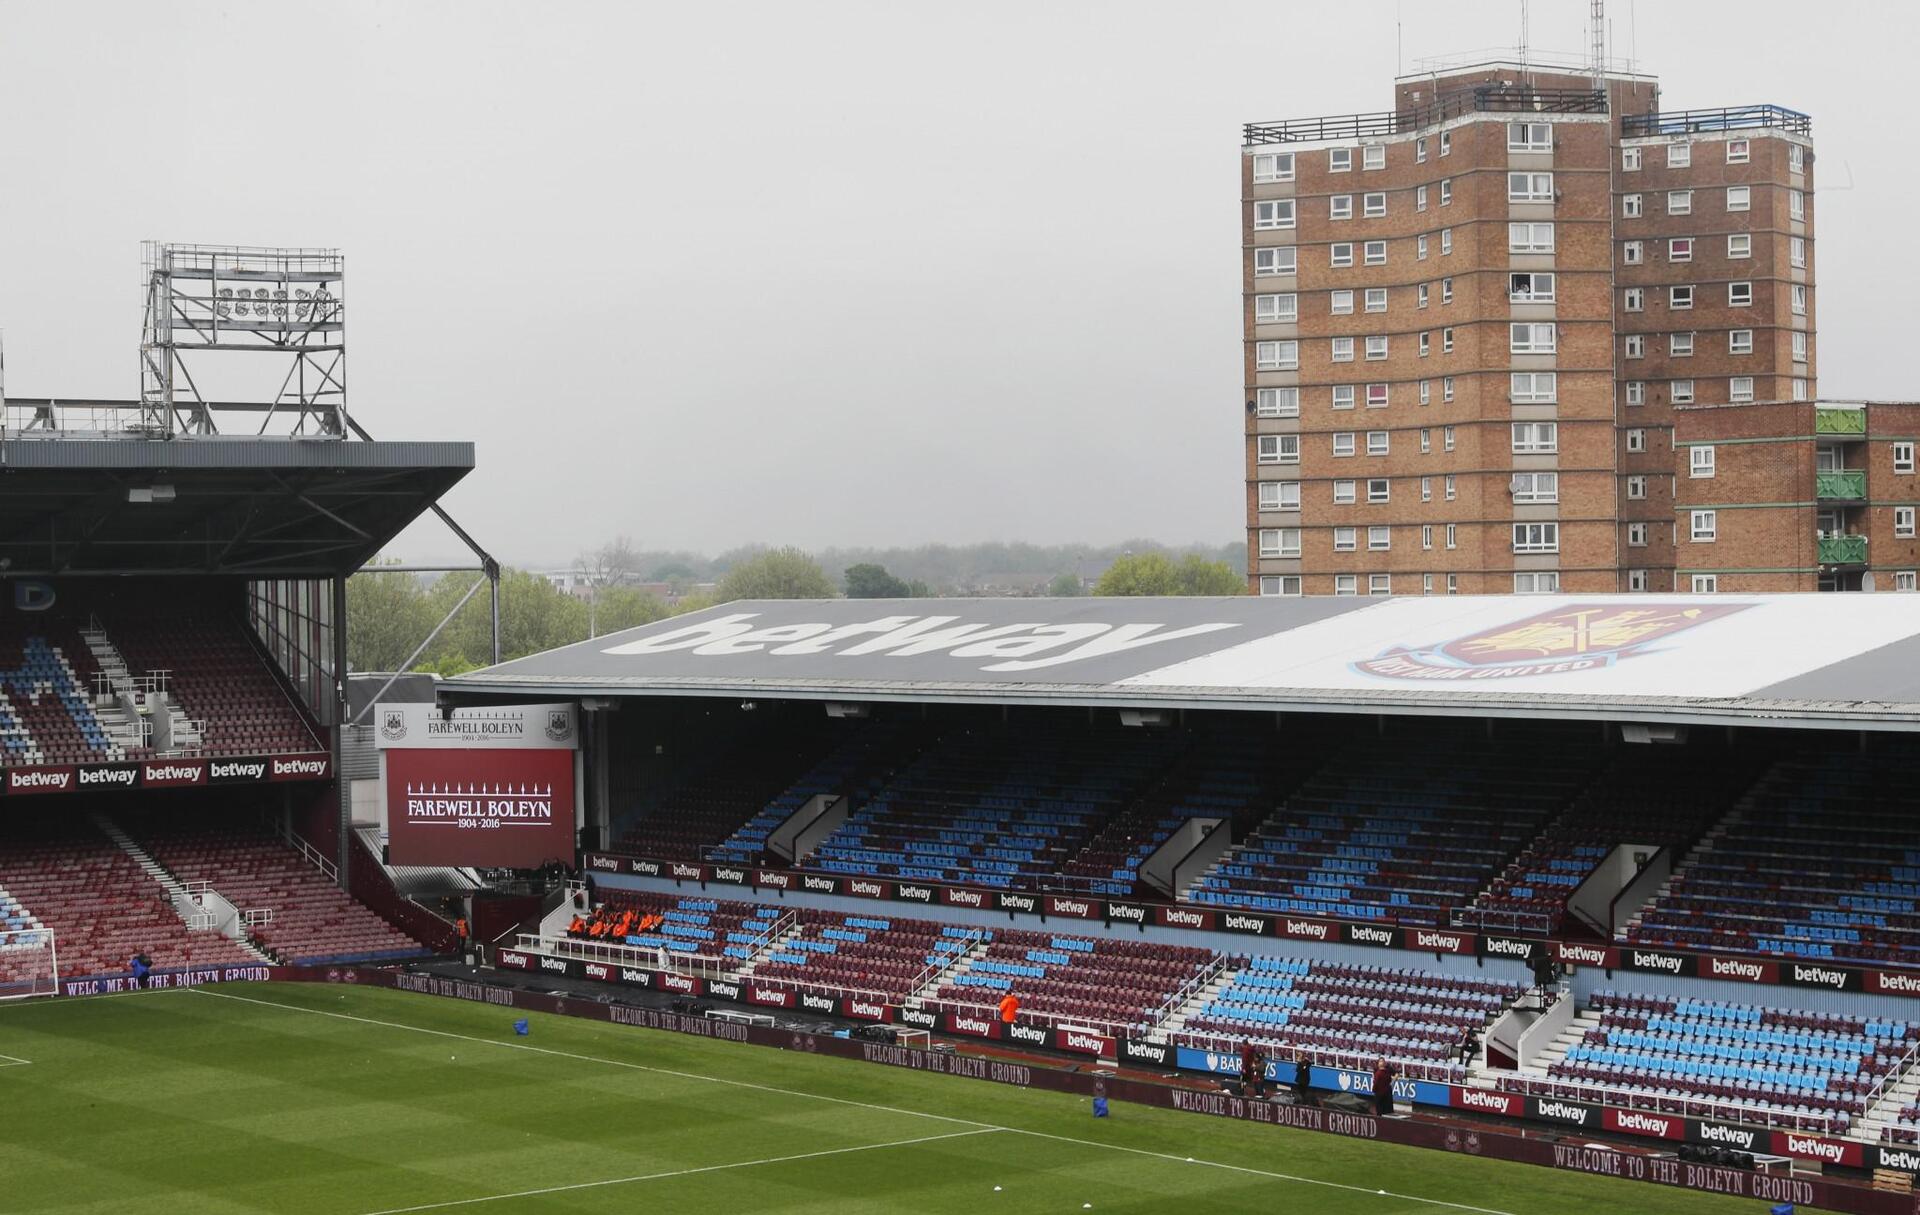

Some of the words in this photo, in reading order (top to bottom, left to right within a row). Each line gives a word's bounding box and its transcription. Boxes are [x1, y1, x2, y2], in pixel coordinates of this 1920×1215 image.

[600, 613, 1243, 672] betway
[1471, 660, 1594, 678] UNITED
[428, 722, 480, 734] FAREWELL
[481, 722, 523, 734] BOLEYN
[12, 771, 70, 788] betway
[80, 767, 137, 784] betway
[146, 762, 202, 782] betway
[211, 759, 265, 779] betway
[274, 758, 327, 776] betway
[408, 800, 486, 816] FAREWELL
[488, 800, 551, 818] BOLEYN
[593, 856, 618, 871] betway
[632, 860, 658, 876] betway
[673, 864, 700, 879] betway
[716, 868, 744, 883] betway
[760, 872, 788, 886] betway
[804, 876, 834, 892] betway
[852, 880, 882, 896] betway
[900, 884, 931, 901] betway
[950, 889, 982, 906] betway
[1001, 894, 1034, 911] betway
[1054, 898, 1088, 916] betway
[1109, 903, 1144, 922] betway
[1166, 908, 1203, 927] betway
[1226, 914, 1264, 933] betway
[1287, 919, 1327, 939] betway
[1351, 926, 1392, 945] betway
[1418, 932, 1460, 952] betway
[1487, 938, 1532, 958] betway
[1560, 944, 1606, 966] betway
[1634, 952, 1682, 974] betway
[1712, 959, 1763, 980] betway
[1794, 966, 1846, 988] betway
[66, 978, 124, 996] WELCME
[147, 974, 170, 988] THE
[176, 970, 219, 987] BOLEYN
[226, 967, 270, 982] GROUND
[396, 974, 427, 993] WELCOME
[429, 978, 438, 994] TO
[440, 978, 454, 996] THE
[456, 980, 482, 1000] BOLEYN
[486, 986, 513, 1006] GROUND
[610, 1004, 646, 1025] WELCOME
[649, 1010, 659, 1026] TO
[662, 1012, 677, 1030] THE
[680, 1016, 712, 1034] BOLEYN
[715, 1022, 748, 1042] GROUND
[502, 951, 527, 968] betway
[541, 956, 567, 974] betway
[586, 964, 608, 980] etway
[623, 968, 650, 986] betway
[665, 974, 693, 992] betway
[710, 980, 739, 999] betway
[756, 987, 786, 1005] betway
[803, 993, 834, 1012] betway
[852, 1000, 884, 1020] betway
[902, 1007, 936, 1027] betway
[956, 1015, 990, 1036] betway
[1010, 1024, 1046, 1044] betway
[1068, 1032, 1104, 1054] betway
[1128, 1040, 1165, 1063] betway
[1221, 1056, 1276, 1077] BARYS
[1354, 1075, 1416, 1098] BAAYS
[1463, 1089, 1509, 1113] betway
[1538, 1099, 1587, 1124] betway
[1618, 1110, 1668, 1136] betway
[1700, 1122, 1754, 1149] betway
[1788, 1135, 1844, 1162] betway
[1880, 1148, 1920, 1170] betw
[864, 1044, 908, 1065] WELCOME
[911, 1050, 923, 1068] TO
[926, 1052, 946, 1072] THE
[950, 1054, 986, 1078] BOLEYN
[991, 1061, 1030, 1085] GROUND
[1172, 1089, 1226, 1114] WELCOME
[1230, 1097, 1244, 1118] TO
[1250, 1099, 1271, 1121] THE
[1277, 1101, 1322, 1130] BOLEYN
[1328, 1112, 1377, 1138] GROUND
[1554, 1144, 1620, 1174] WELCOME
[1626, 1158, 1644, 1179] TO
[1650, 1160, 1678, 1186] THE
[1688, 1166, 1743, 1195] BOLEYN
[1752, 1173, 1814, 1204] GROUND
